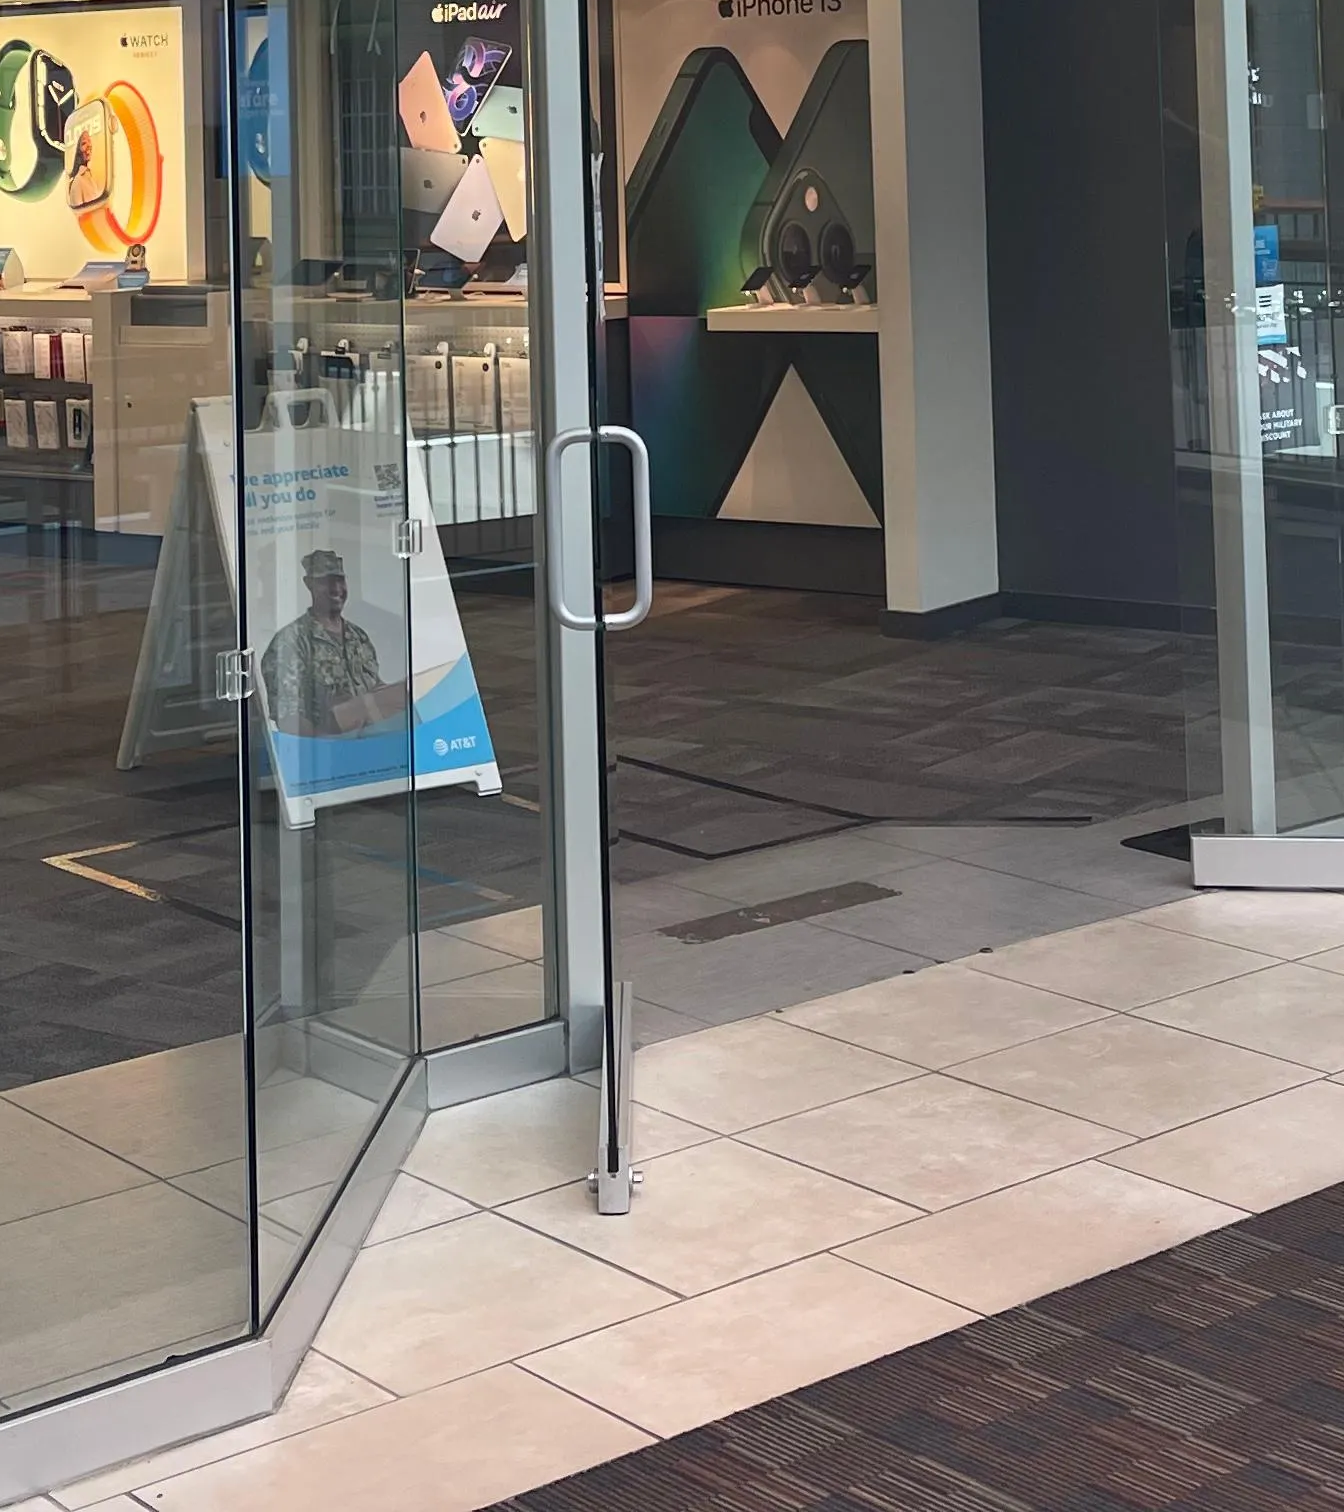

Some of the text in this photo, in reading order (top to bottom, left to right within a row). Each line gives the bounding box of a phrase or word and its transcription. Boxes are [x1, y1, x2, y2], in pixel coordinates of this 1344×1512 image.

[443, 0, 508, 23] iPad air
[129, 33, 169, 48] WATCH
[1272, 408, 1294, 419] ABOUT
[262, 464, 350, 488] appreciate
[261, 490, 292, 510] you
[295, 486, 317, 502] do
[450, 735, 477, 752] AT&T
